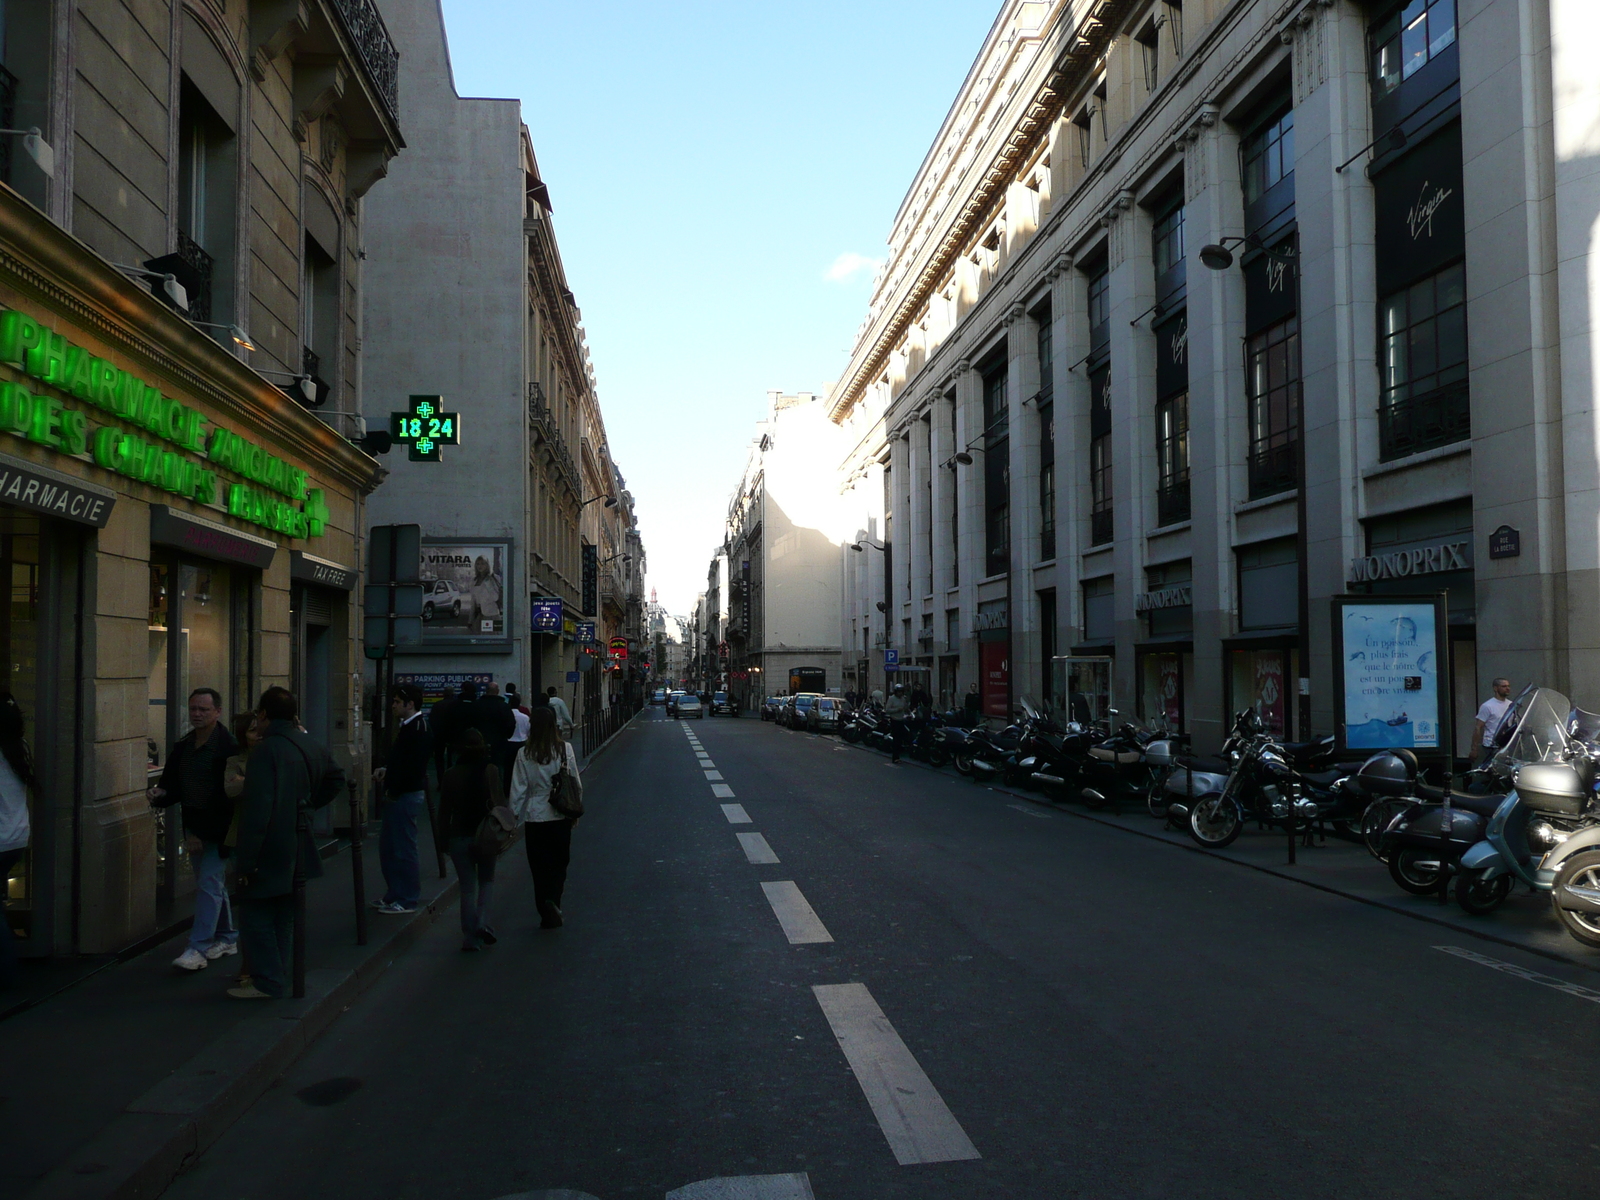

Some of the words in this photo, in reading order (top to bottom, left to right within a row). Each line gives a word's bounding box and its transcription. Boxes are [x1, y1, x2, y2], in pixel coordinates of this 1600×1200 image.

[1406, 180, 1453, 240] Virgin
[0, 310, 209, 453] PHARMACIE
[208, 427, 310, 501] ANGLAISE
[399, 417, 422, 438] 18
[428, 417, 453, 438] 24
[0, 381, 87, 456] DES
[94, 426, 218, 505] CHAMPS
[228, 483, 310, 540] ELYSEES
[184, 526, 261, 563] PARFUMERIE
[428, 555, 472, 564] VITARA
[1352, 541, 1471, 582] MONOPRIX
[312, 564, 328, 581] TAX
[327, 570, 347, 586] FREE
[1370, 650, 1389, 660] plus
[1391, 650, 1409, 659] frais
[1383, 662, 1391, 671] le
[414, 675, 446, 683] PARKING
[447, 675, 473, 683] PUBLIC
[1361, 687, 1390, 695] encore
